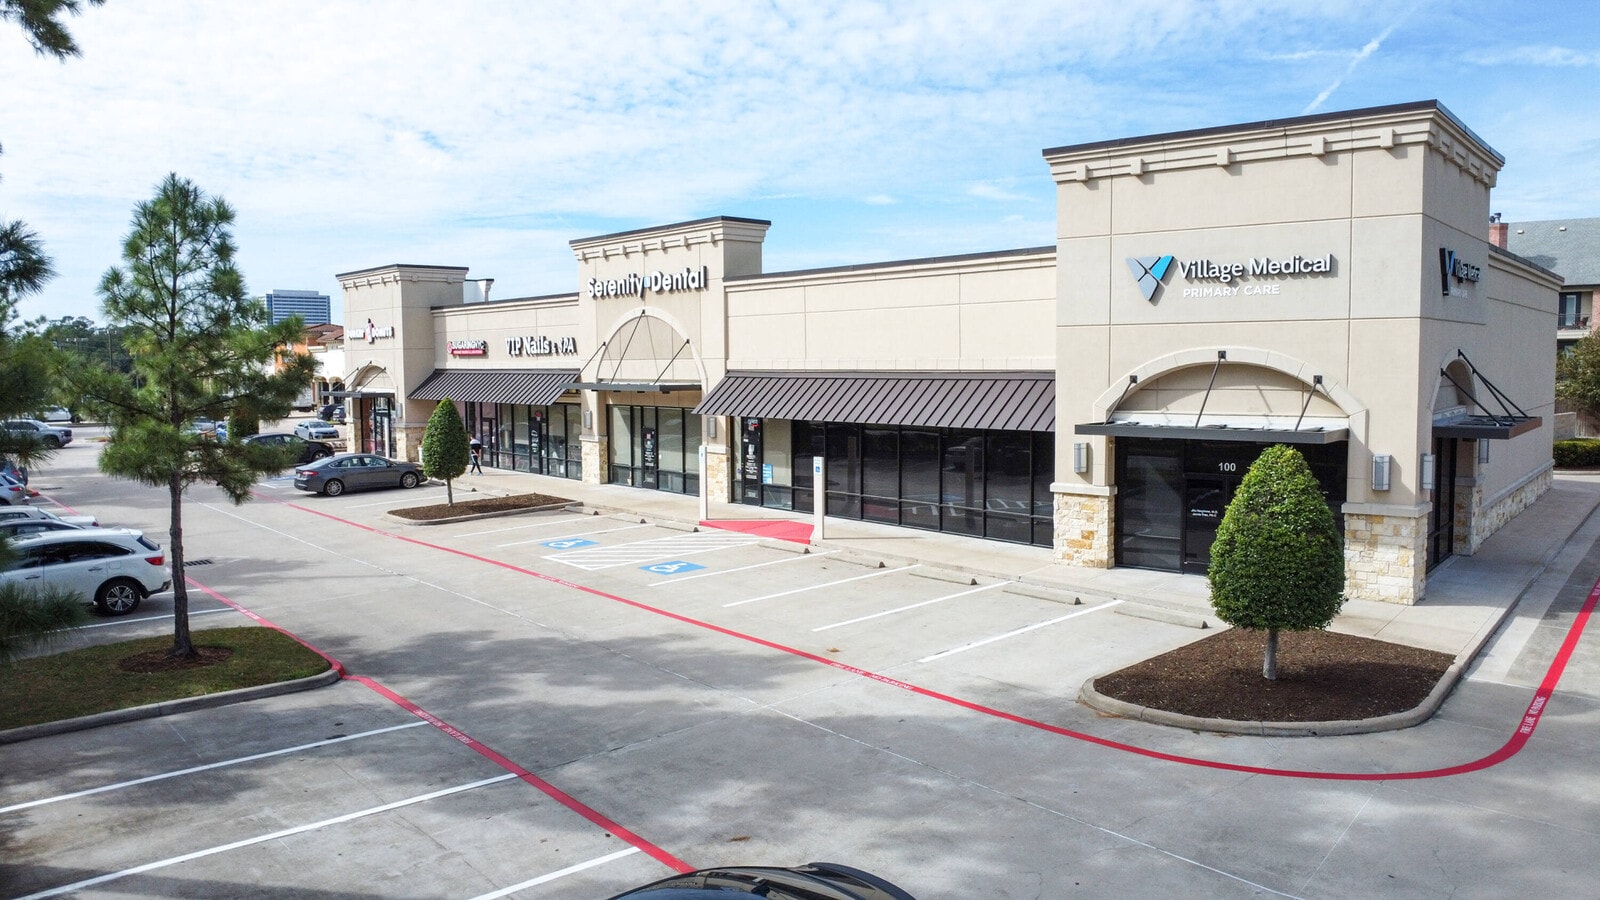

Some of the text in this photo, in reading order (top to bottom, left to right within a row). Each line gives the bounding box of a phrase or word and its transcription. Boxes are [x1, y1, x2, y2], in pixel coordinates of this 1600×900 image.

[1178, 253, 1333, 282] Village Medical
[587, 266, 705, 298] Serenity Dental
[1183, 284, 1281, 299] PRIMARY CARE
[505, 336, 523, 355] VIP
[523, 335, 551, 354] Nails
[1218, 462, 1237, 472] 100
